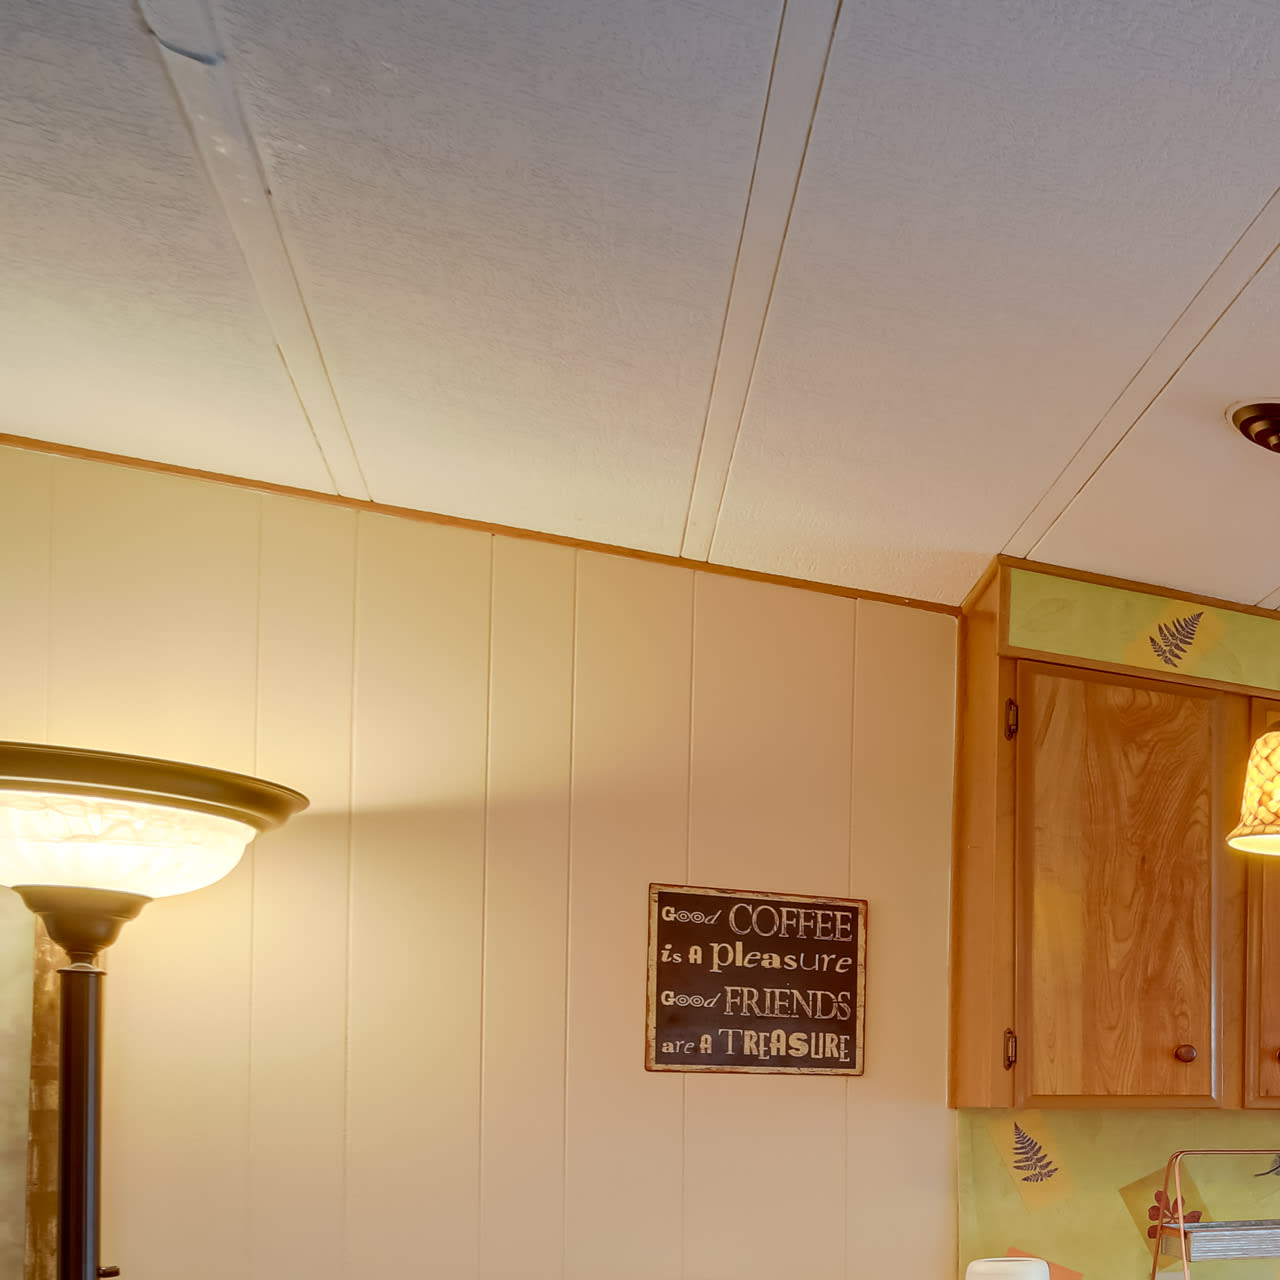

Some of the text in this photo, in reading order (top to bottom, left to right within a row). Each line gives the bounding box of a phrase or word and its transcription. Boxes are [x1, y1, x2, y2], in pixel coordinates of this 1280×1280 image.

[661, 903, 853, 942] Good COFFEE
[661, 944, 683, 964] is
[688, 945, 703, 965] A
[661, 985, 852, 1021] Good FRIENDS
[661, 1028, 851, 1062] are A TREASURE
